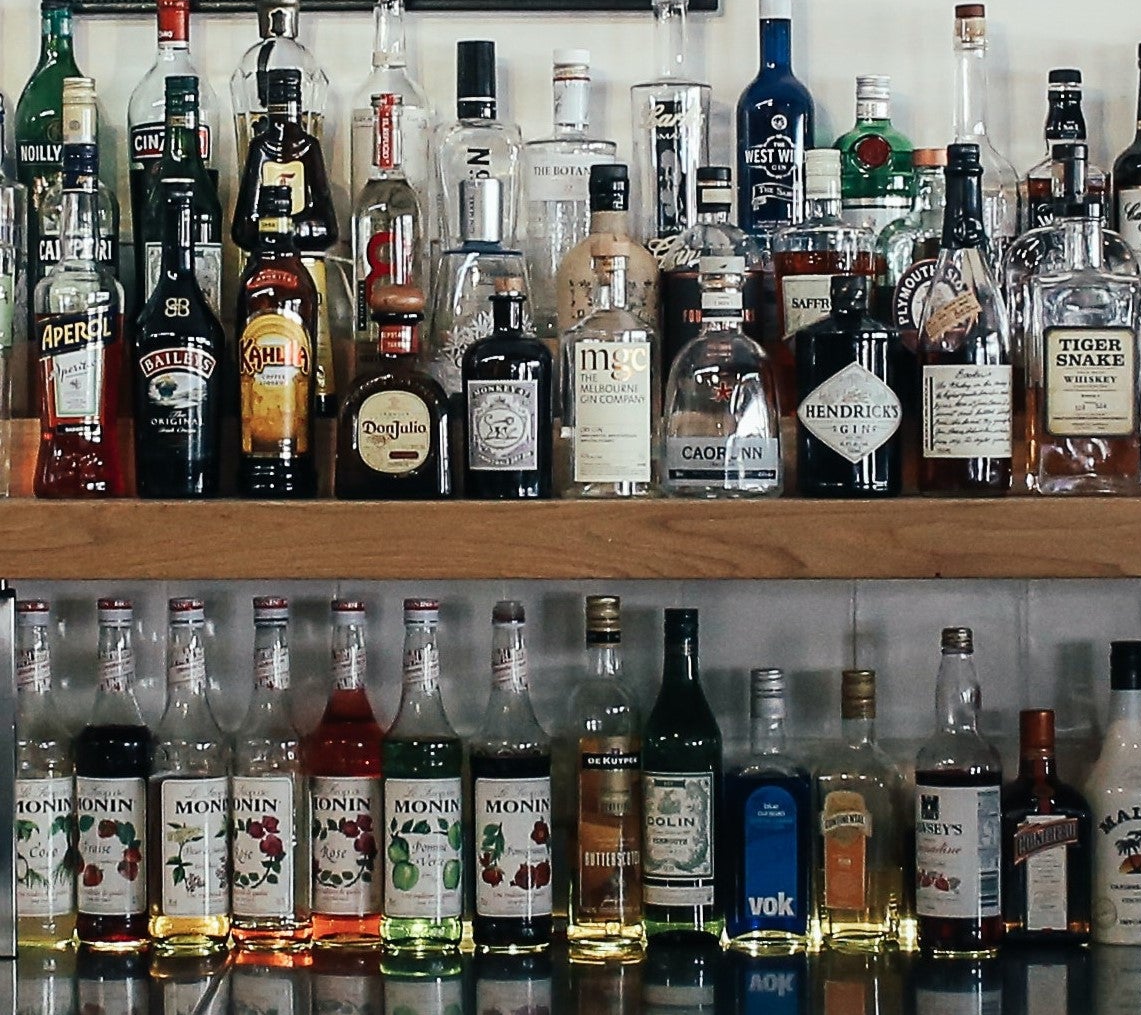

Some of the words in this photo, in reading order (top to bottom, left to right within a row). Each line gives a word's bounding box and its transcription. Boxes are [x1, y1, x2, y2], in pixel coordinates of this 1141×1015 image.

[20, 144, 62, 162] NOILLY
[745, 149, 774, 164] WEST
[553, 166, 591, 176] BOTAN
[792, 297, 831, 309] SAFFR
[42, 317, 112, 351] APEROL
[1059, 338, 1122, 352] TIGER
[240, 337, 309, 373] KAHLA
[1056, 353, 1125, 367] SNAKE
[581, 348, 647, 381] mgc
[580, 373, 598, 383] THE
[1063, 375, 1118, 384] WHISKEY
[580, 384, 639, 394] MELBOURNE
[805, 404, 899, 420] HENDRICK'S
[682, 446, 763, 461] CAORNN
[395, 798, 459, 814] MONIN
[486, 798, 550, 814] MONIN
[647, 816, 695, 827] DOLIN
[748, 892, 794, 917] vok
